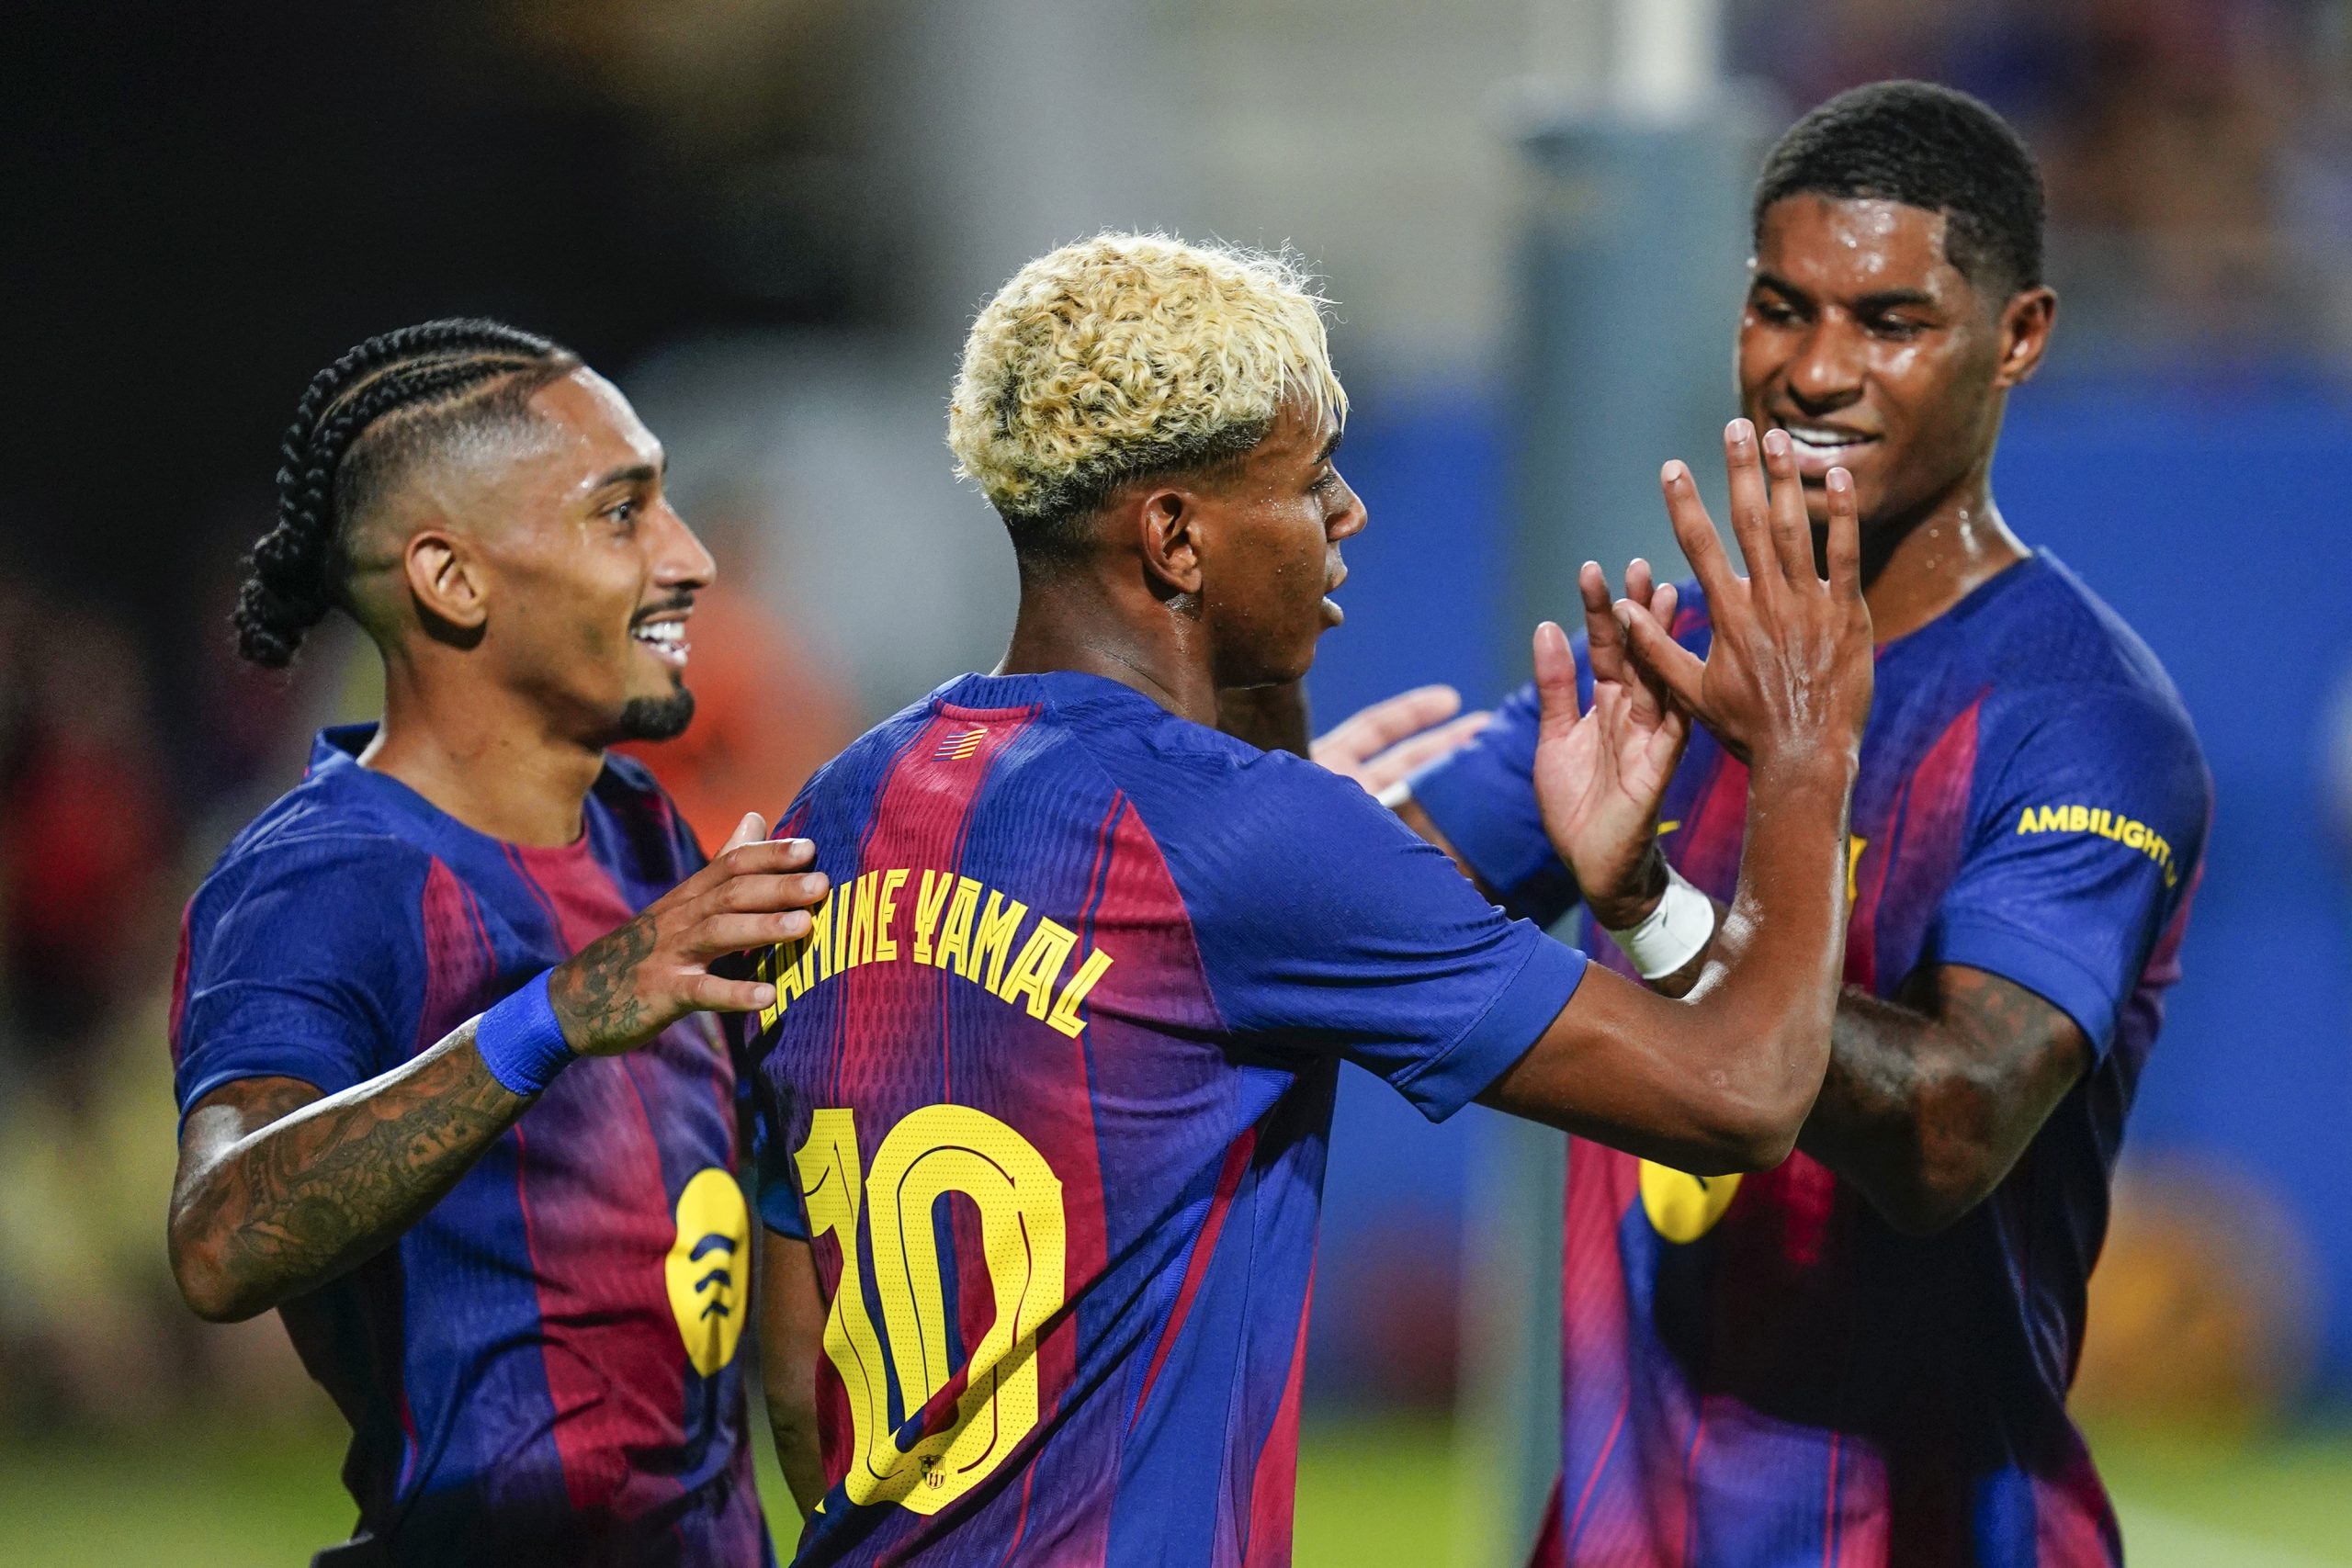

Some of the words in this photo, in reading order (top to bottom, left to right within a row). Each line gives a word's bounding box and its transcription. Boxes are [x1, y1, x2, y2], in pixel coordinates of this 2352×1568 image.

[2017, 805, 2171, 866] AMBILIGHT
[913, 869, 1114, 1039] YAMAL
[793, 1103, 1066, 1516] 10
